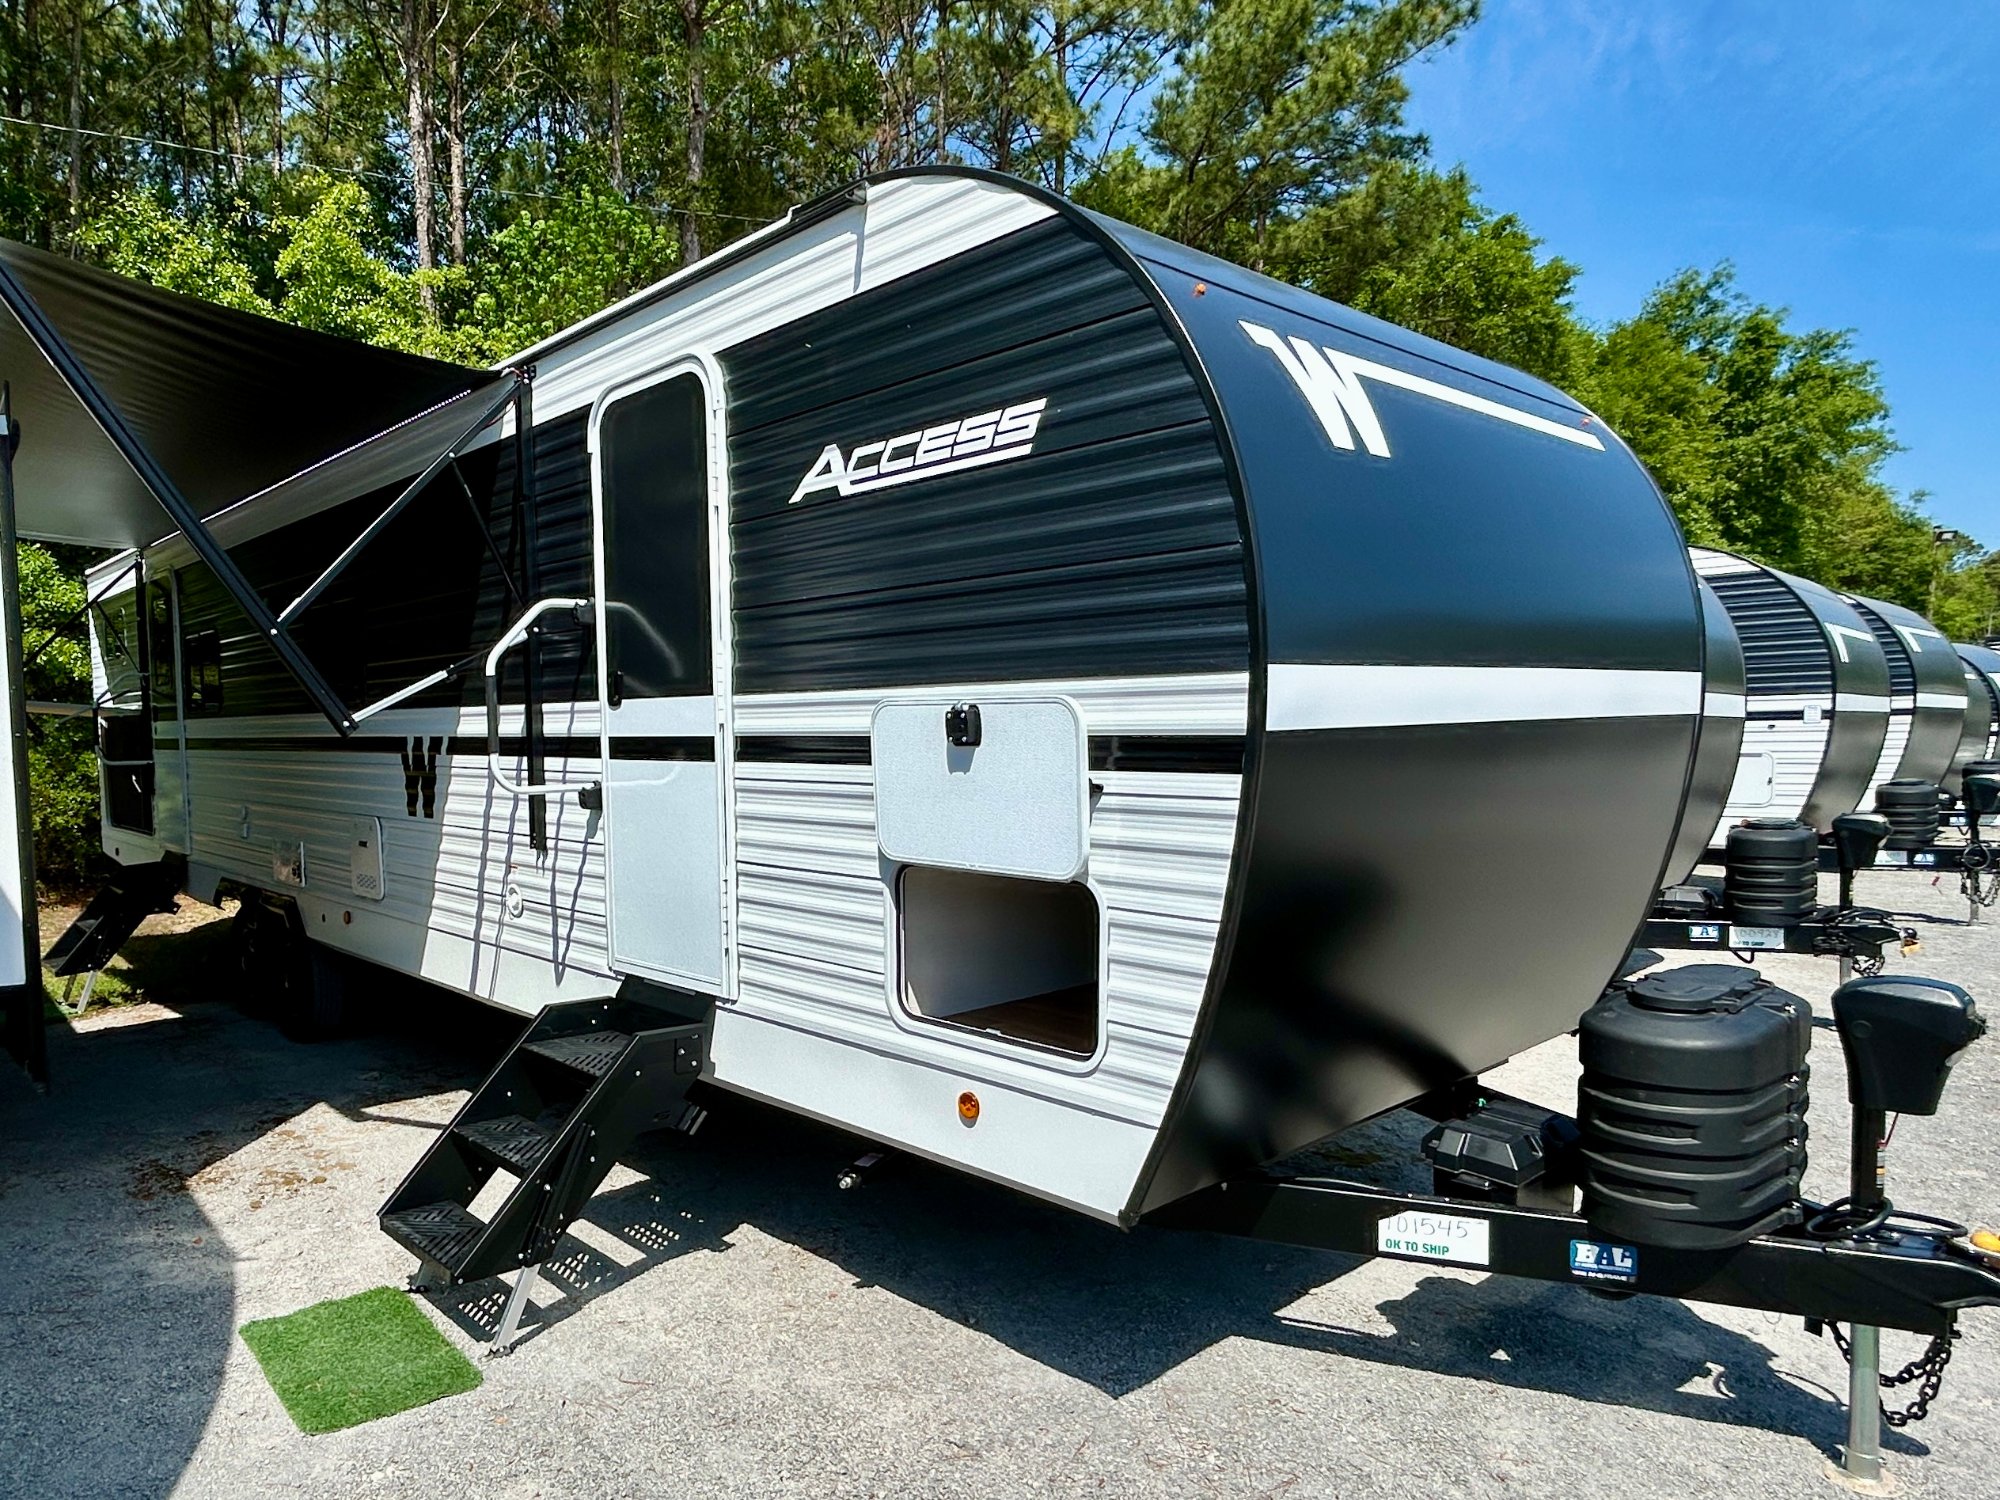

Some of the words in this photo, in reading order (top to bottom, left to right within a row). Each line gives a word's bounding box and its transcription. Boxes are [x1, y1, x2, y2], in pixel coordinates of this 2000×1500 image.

[788, 397, 1047, 504] ACCESS
[1387, 1216, 1471, 1238] 101545
[1385, 1238, 1401, 1250] OK
[1404, 1241, 1418, 1252] TO
[1422, 1243, 1449, 1256] SHIP
[1575, 1243, 1632, 1268] BAL
